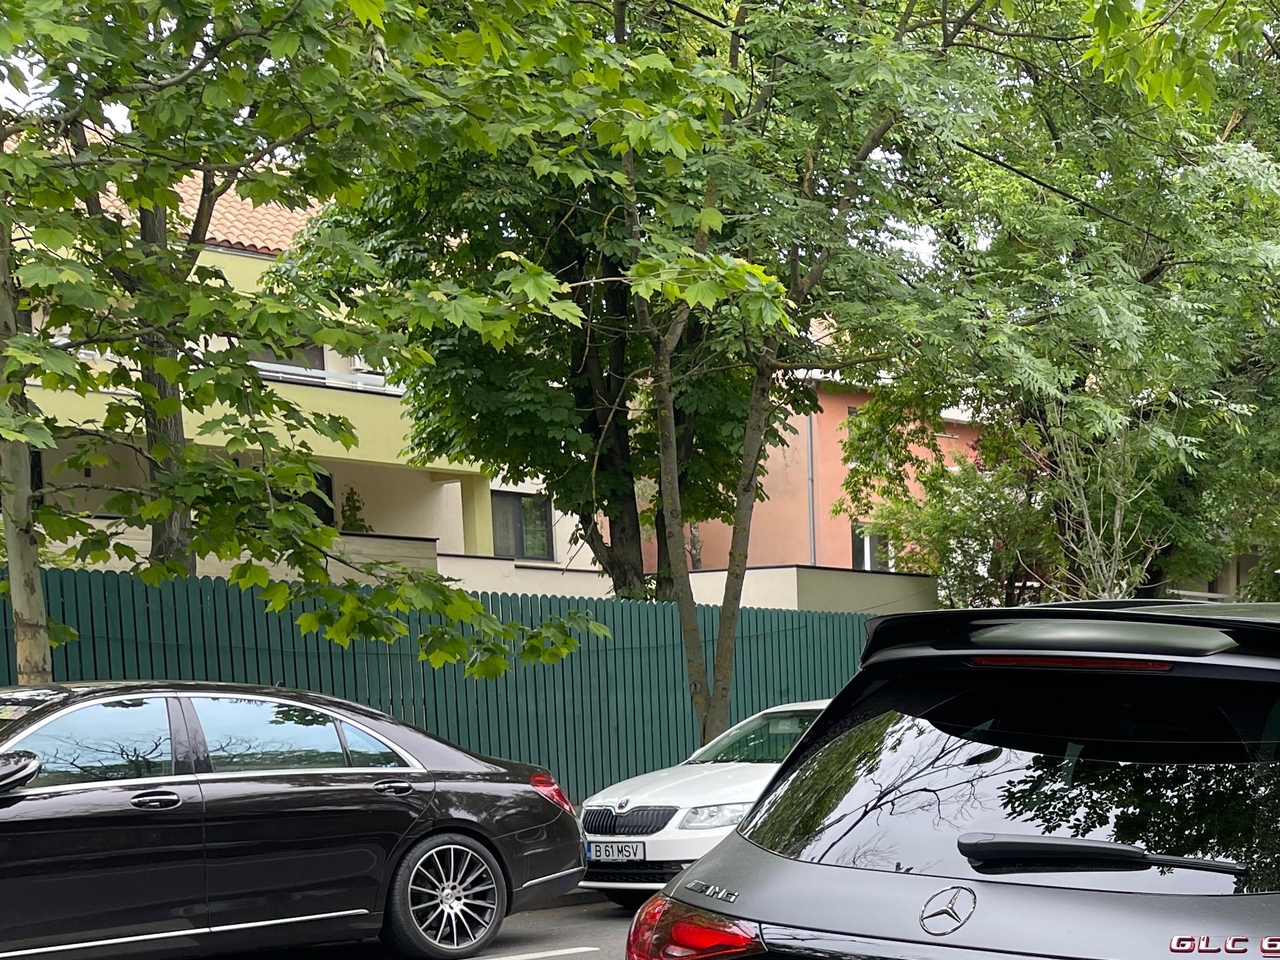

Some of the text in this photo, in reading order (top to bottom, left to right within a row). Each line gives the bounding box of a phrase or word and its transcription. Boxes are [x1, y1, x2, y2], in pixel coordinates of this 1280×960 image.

[595, 845, 602, 857] B
[604, 845, 614, 857] 61
[617, 845, 639, 857] MSV
[1169, 935, 1250, 954] GLC
